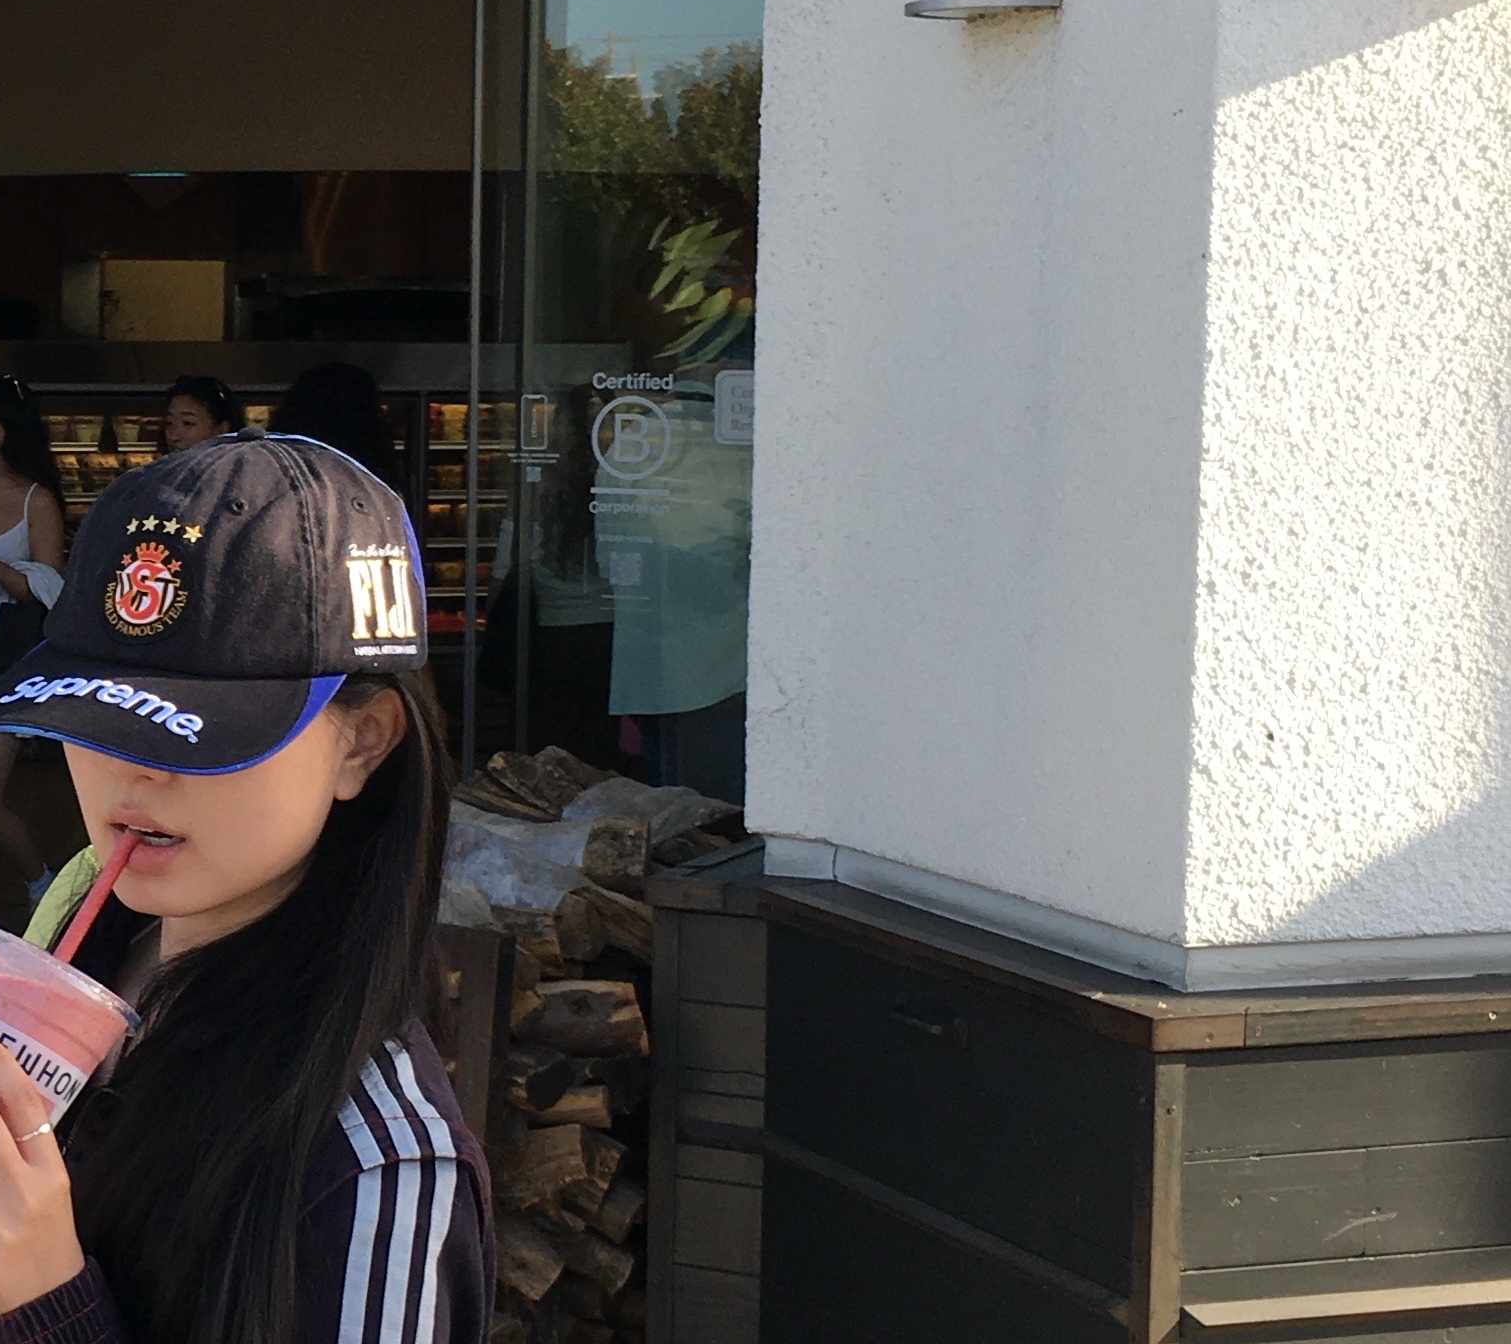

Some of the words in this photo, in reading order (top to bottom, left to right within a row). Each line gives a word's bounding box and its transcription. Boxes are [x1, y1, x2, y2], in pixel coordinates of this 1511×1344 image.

[592, 372, 674, 390] Certified
[613, 413, 651, 463] B
[588, 500, 670, 515] Corporation
[104, 582, 119, 625] WORLD
[115, 620, 165, 637] FAMOUS
[163, 590, 189, 625] TEAM
